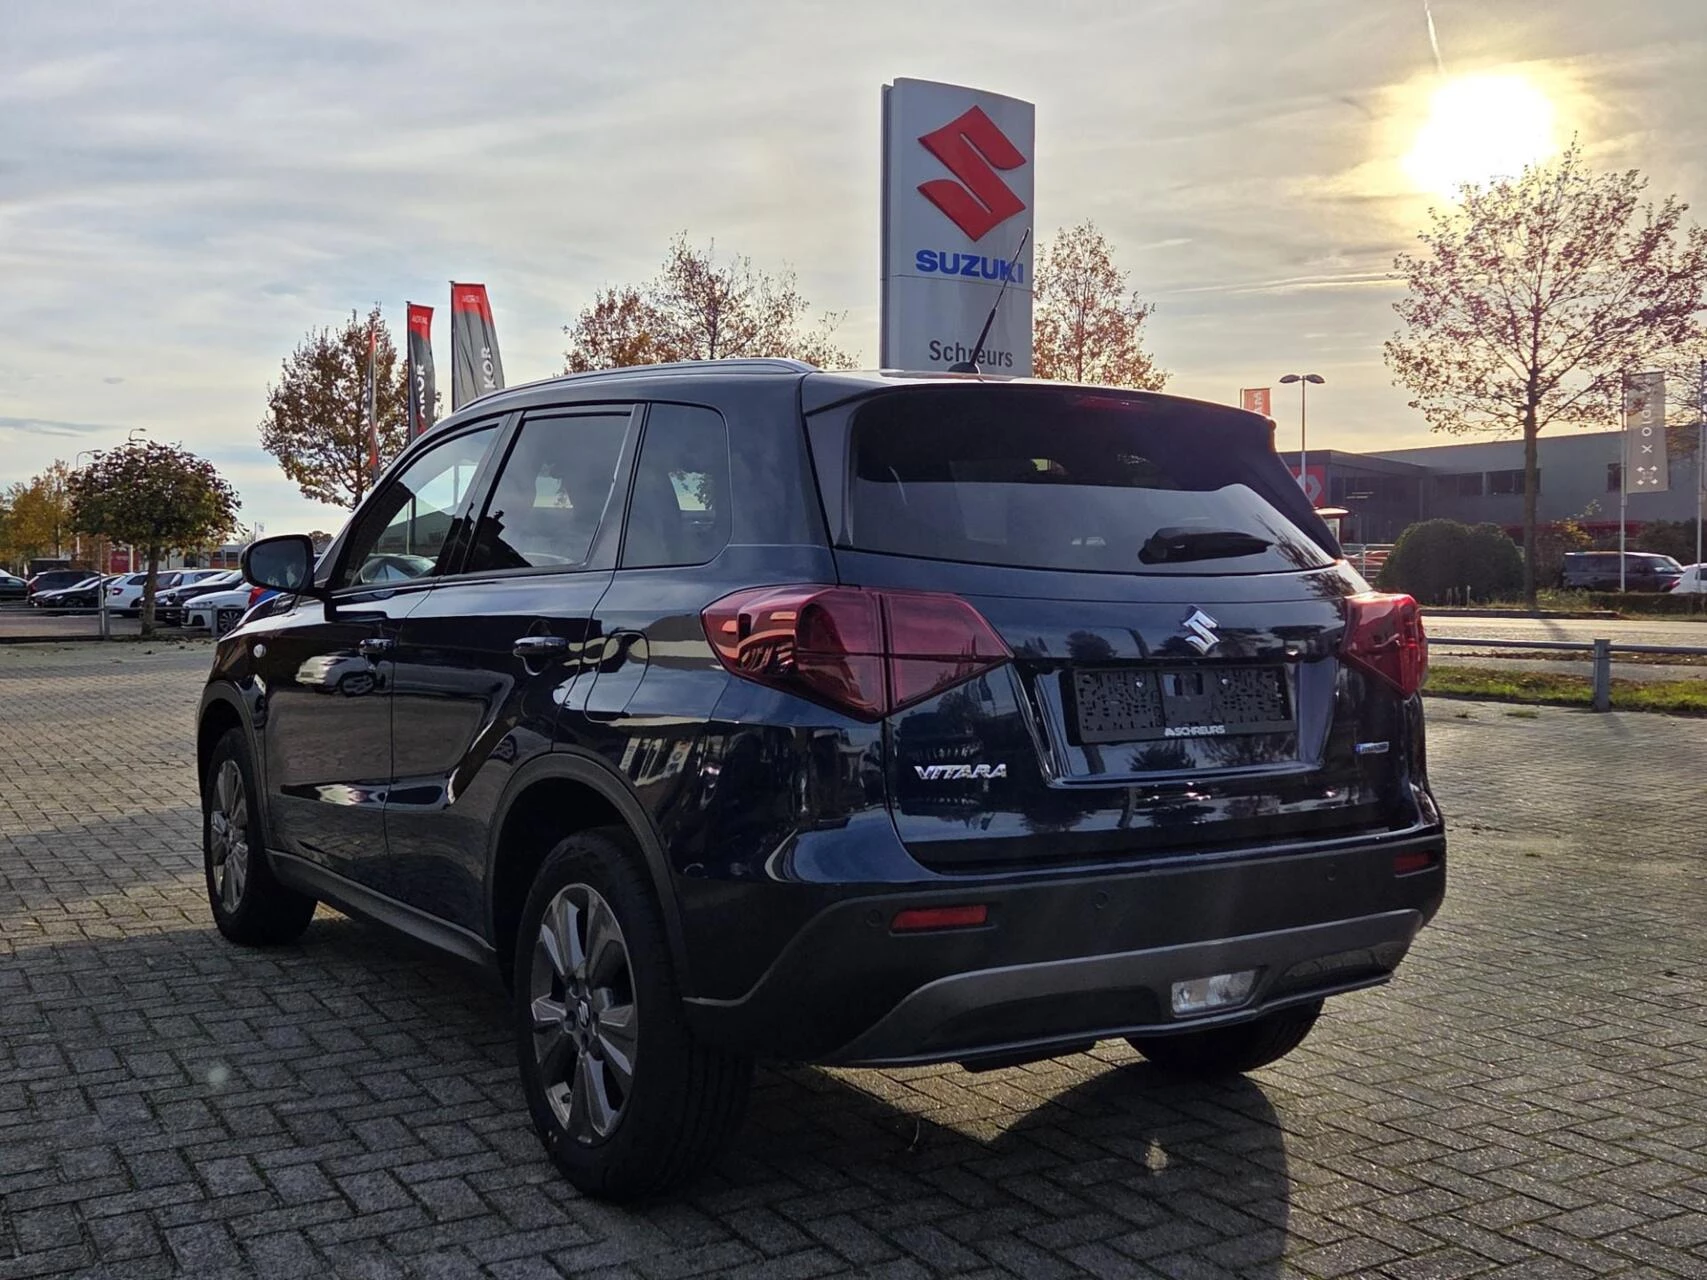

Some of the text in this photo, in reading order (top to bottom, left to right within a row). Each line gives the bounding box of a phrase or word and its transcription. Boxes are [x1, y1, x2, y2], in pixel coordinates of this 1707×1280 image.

[915, 249, 1024, 284] SUZUKI
[481, 347, 497, 390] KOR
[914, 763, 1007, 780] VITARA
